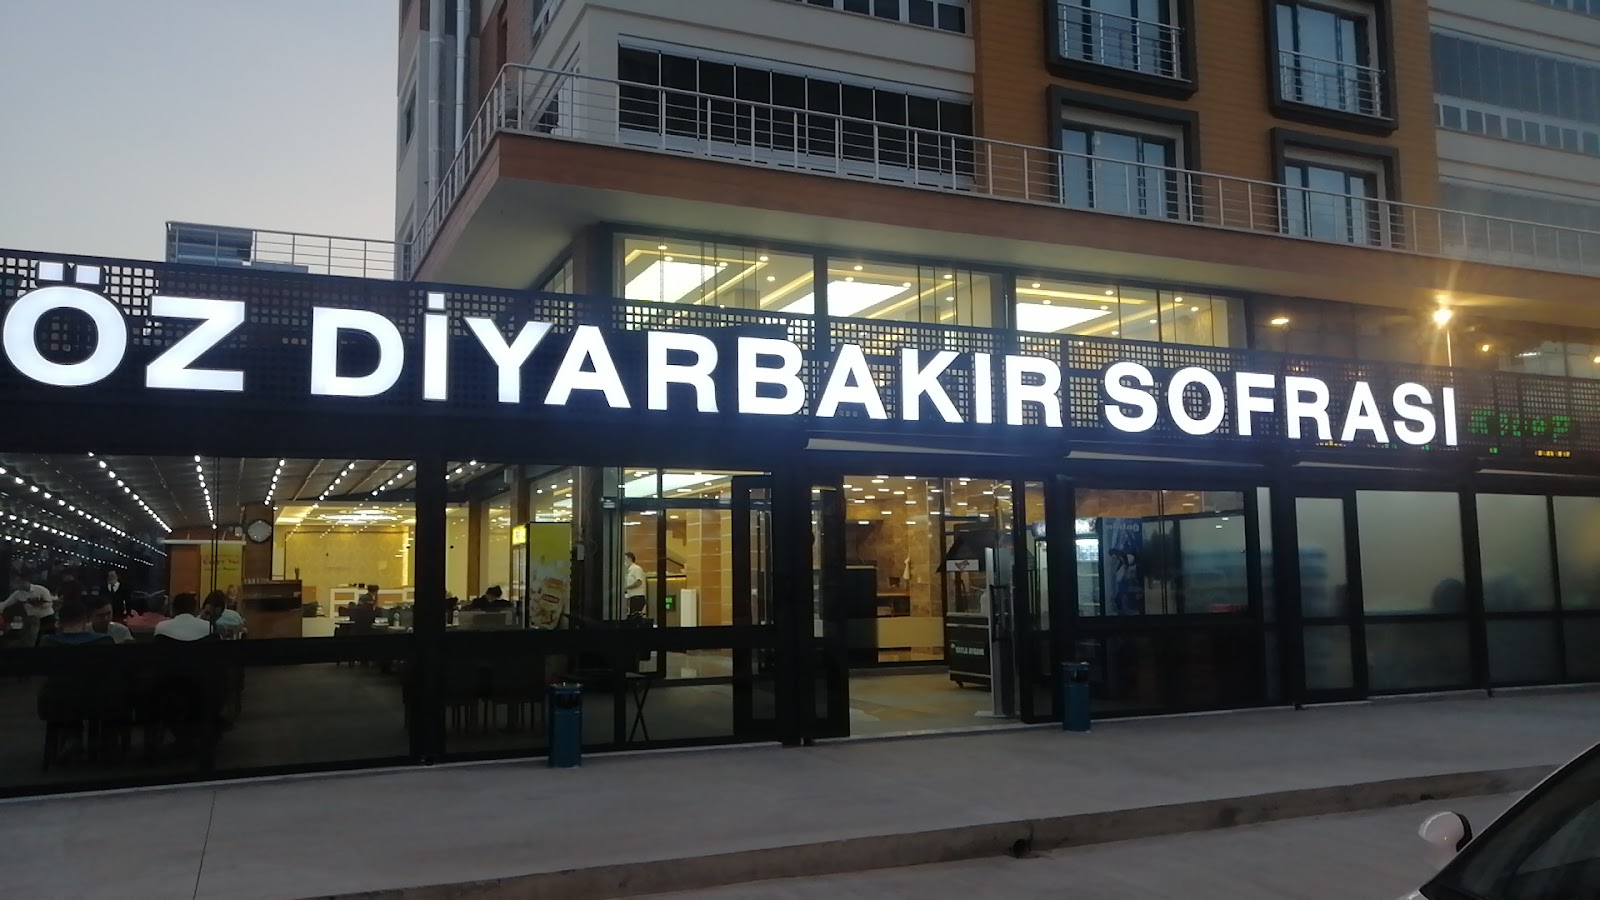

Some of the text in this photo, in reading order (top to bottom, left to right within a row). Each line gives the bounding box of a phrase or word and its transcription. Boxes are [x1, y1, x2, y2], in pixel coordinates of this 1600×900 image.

[3, 262, 1458, 447] ÖZ DİYARBAKIR SOFRASI
